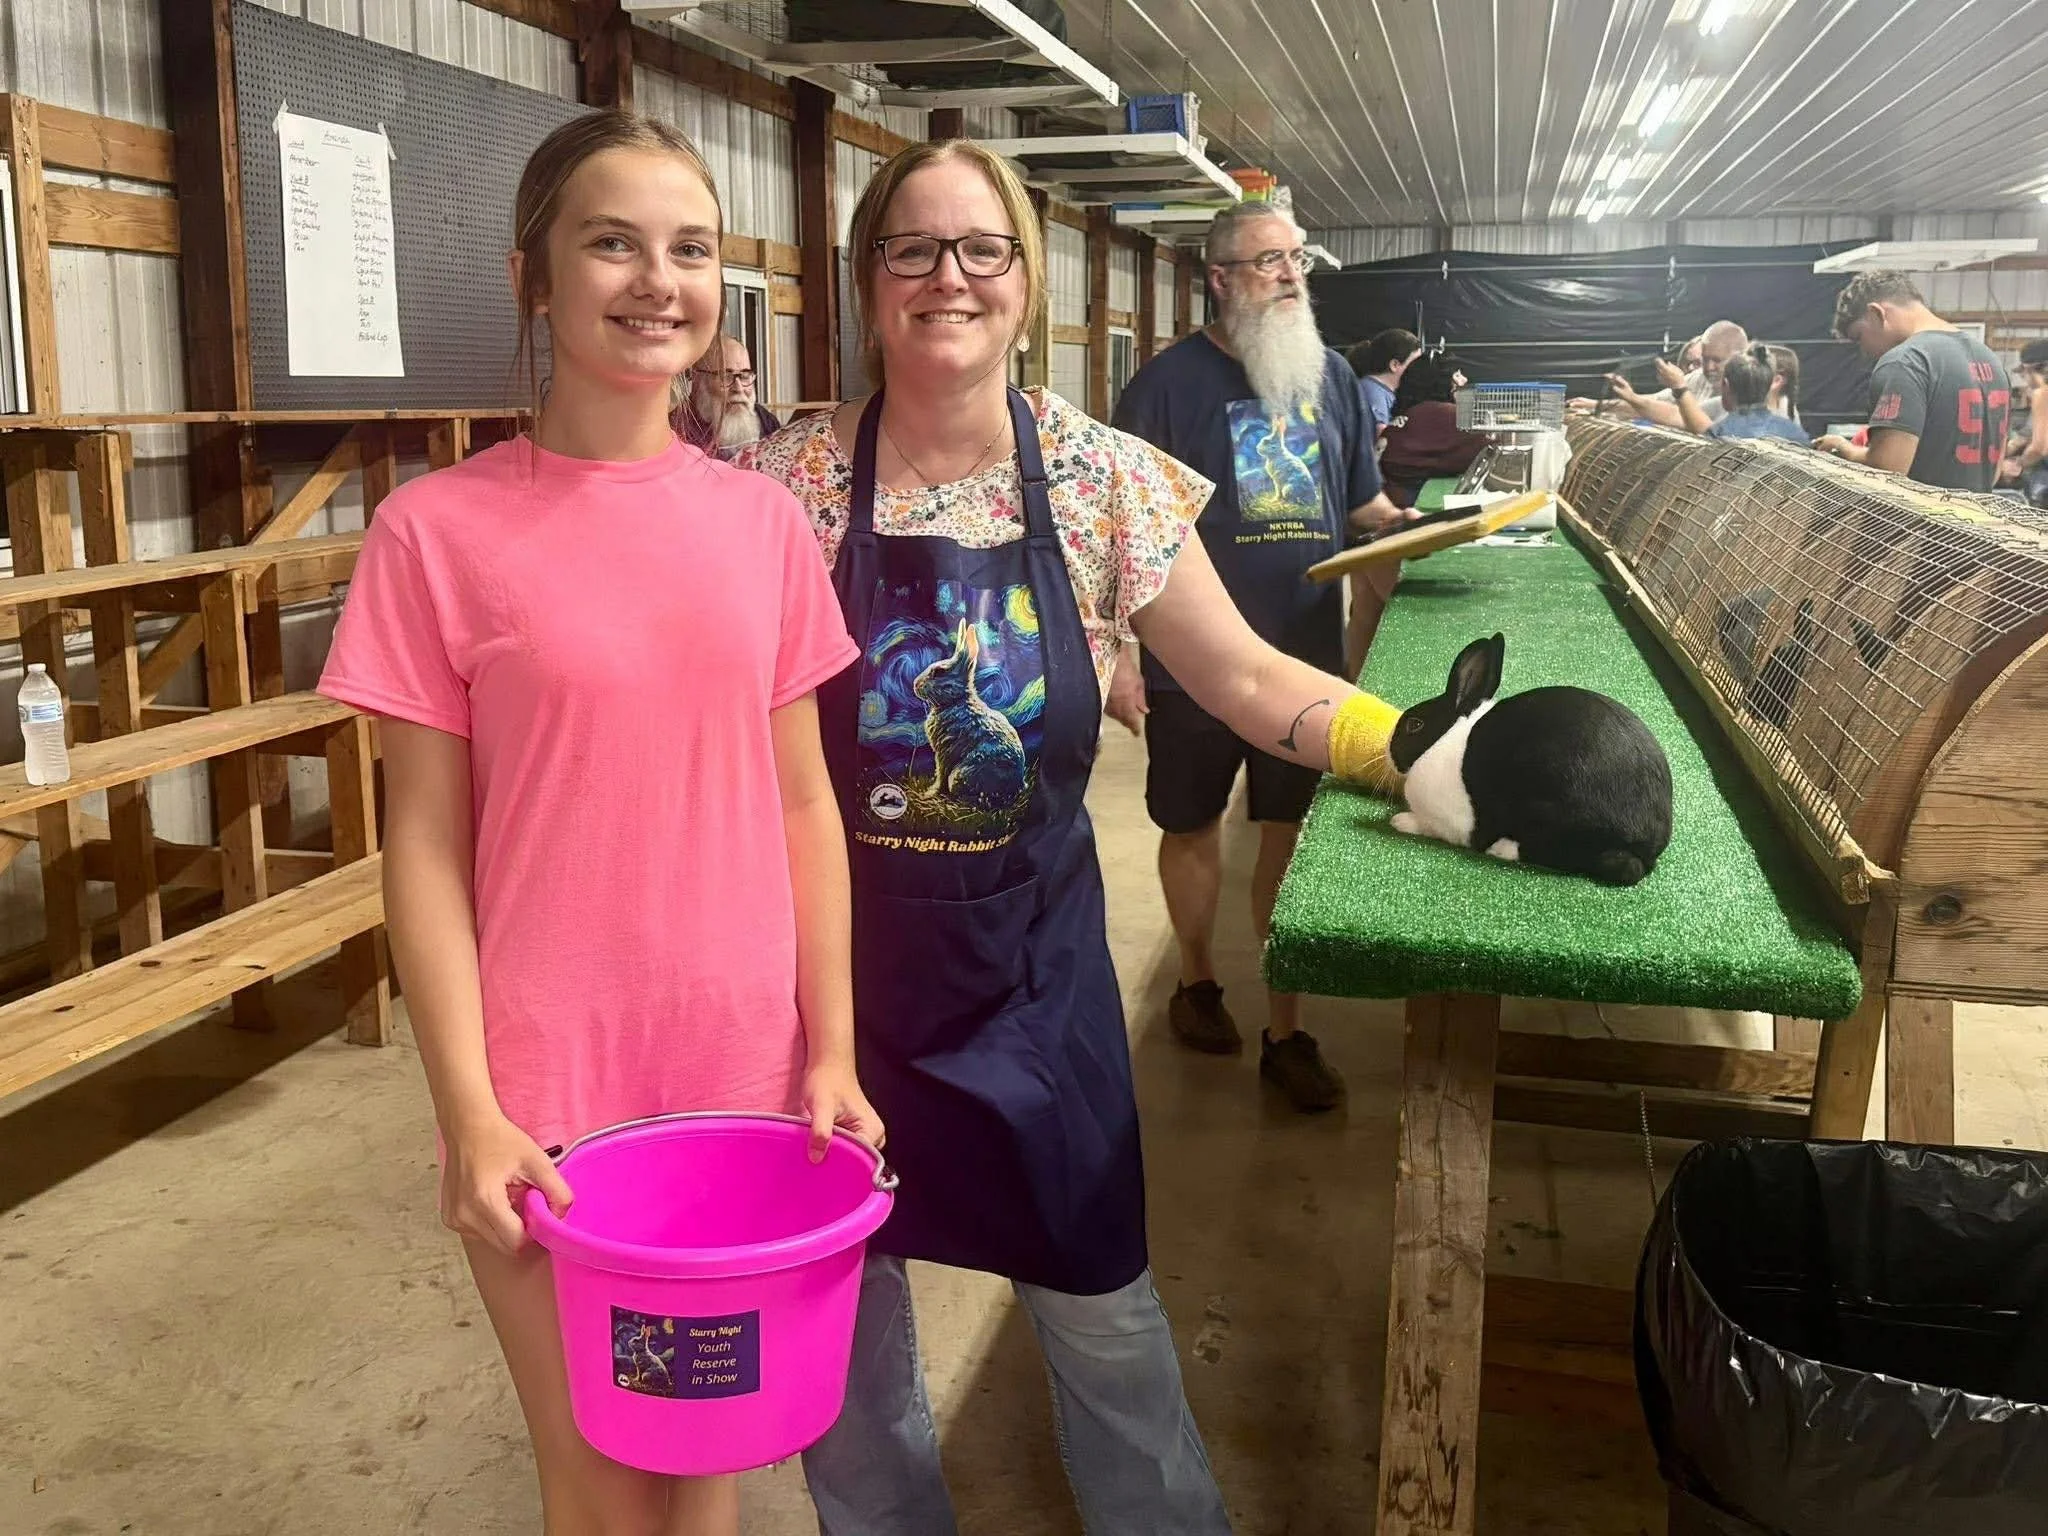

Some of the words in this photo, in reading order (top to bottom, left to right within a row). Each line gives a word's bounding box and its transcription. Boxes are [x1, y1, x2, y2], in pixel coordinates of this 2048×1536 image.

[1235, 534, 1261, 544] Starry
[1263, 531, 1287, 542] Night
[1287, 531, 1312, 540] Rabbit
[855, 831, 902, 849] Starry
[904, 836, 945, 852] Night
[947, 838, 996, 853] Rabbit
[689, 1328, 716, 1338] Starry
[718, 1325, 742, 1337] Night
[698, 1341, 731, 1353] Youth
[692, 1358, 737, 1369] Reserve
[692, 1375, 703, 1385] in
[706, 1373, 738, 1385] Show
